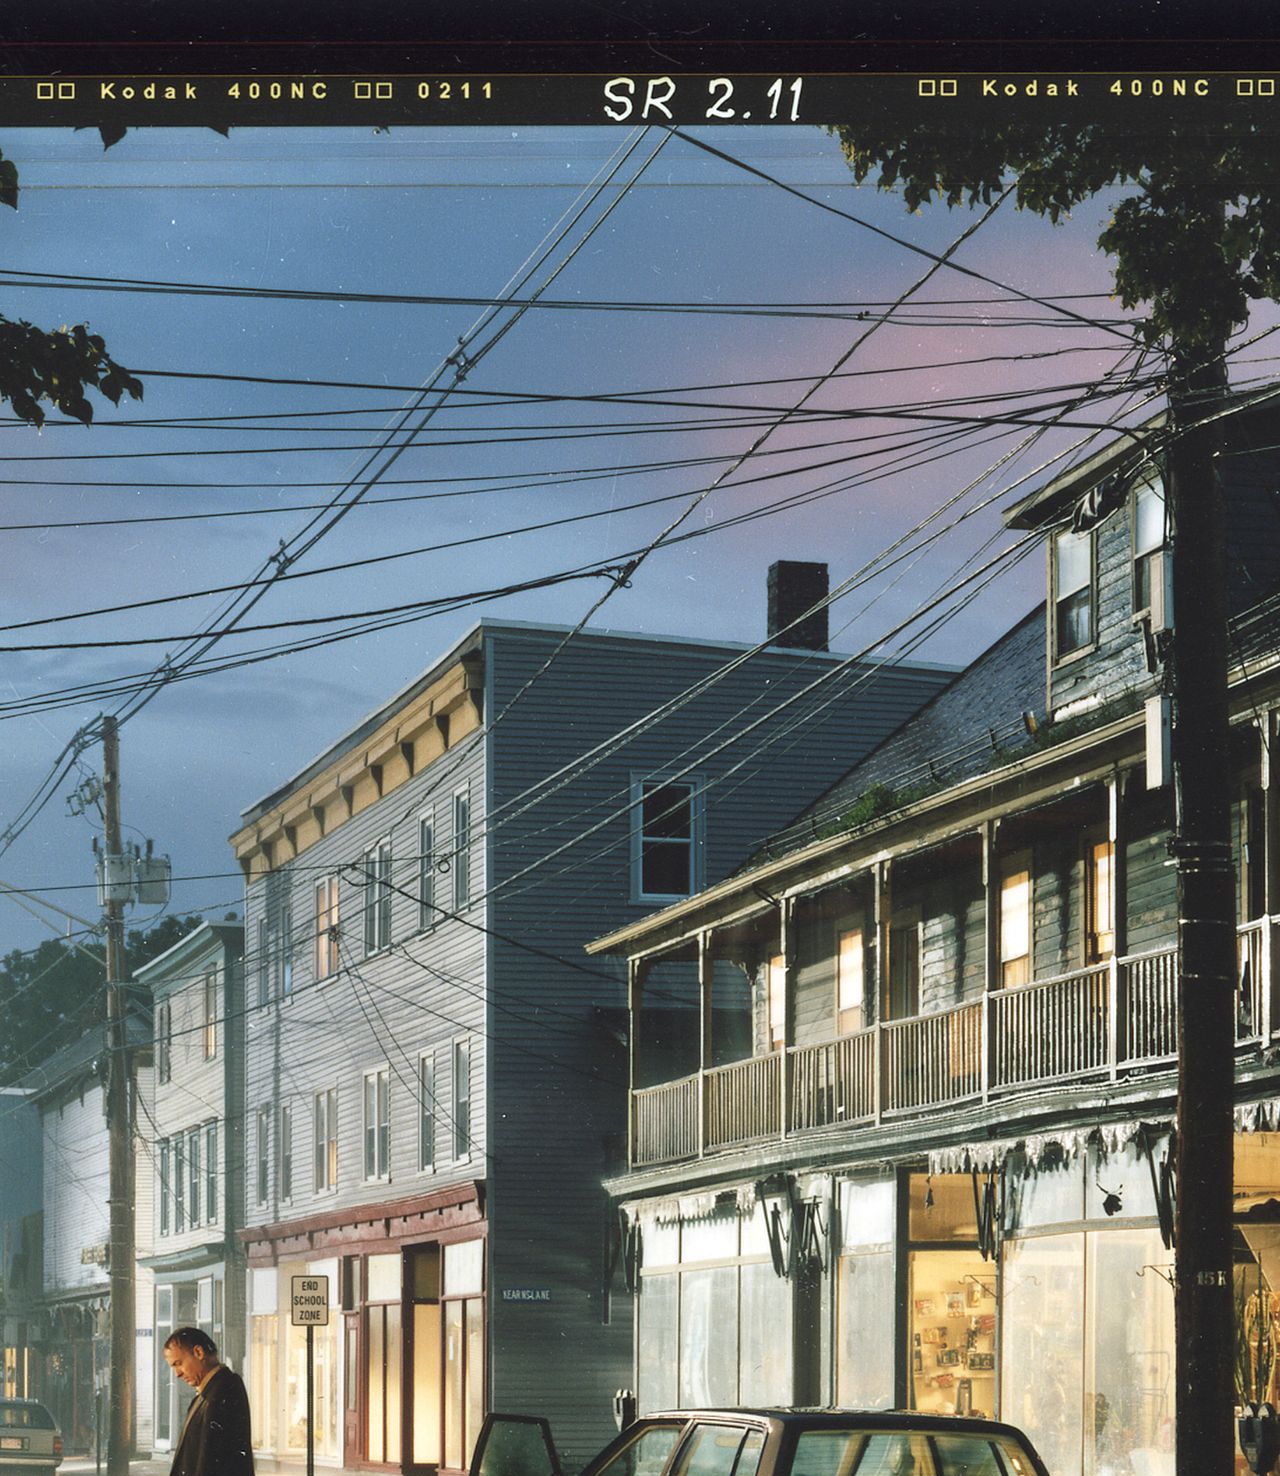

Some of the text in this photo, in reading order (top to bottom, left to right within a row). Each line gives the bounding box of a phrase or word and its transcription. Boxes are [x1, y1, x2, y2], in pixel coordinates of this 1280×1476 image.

[100, 83, 492, 99] Kodak 400NC 0211
[982, 80, 1078, 96] Kodak
[1110, 80, 1208, 96] 400NC
[603, 77, 804, 122] SR 2.11
[301, 1280, 319, 1291] END
[293, 1295, 327, 1306] SCHOOL
[299, 1310, 321, 1321] ZONE
